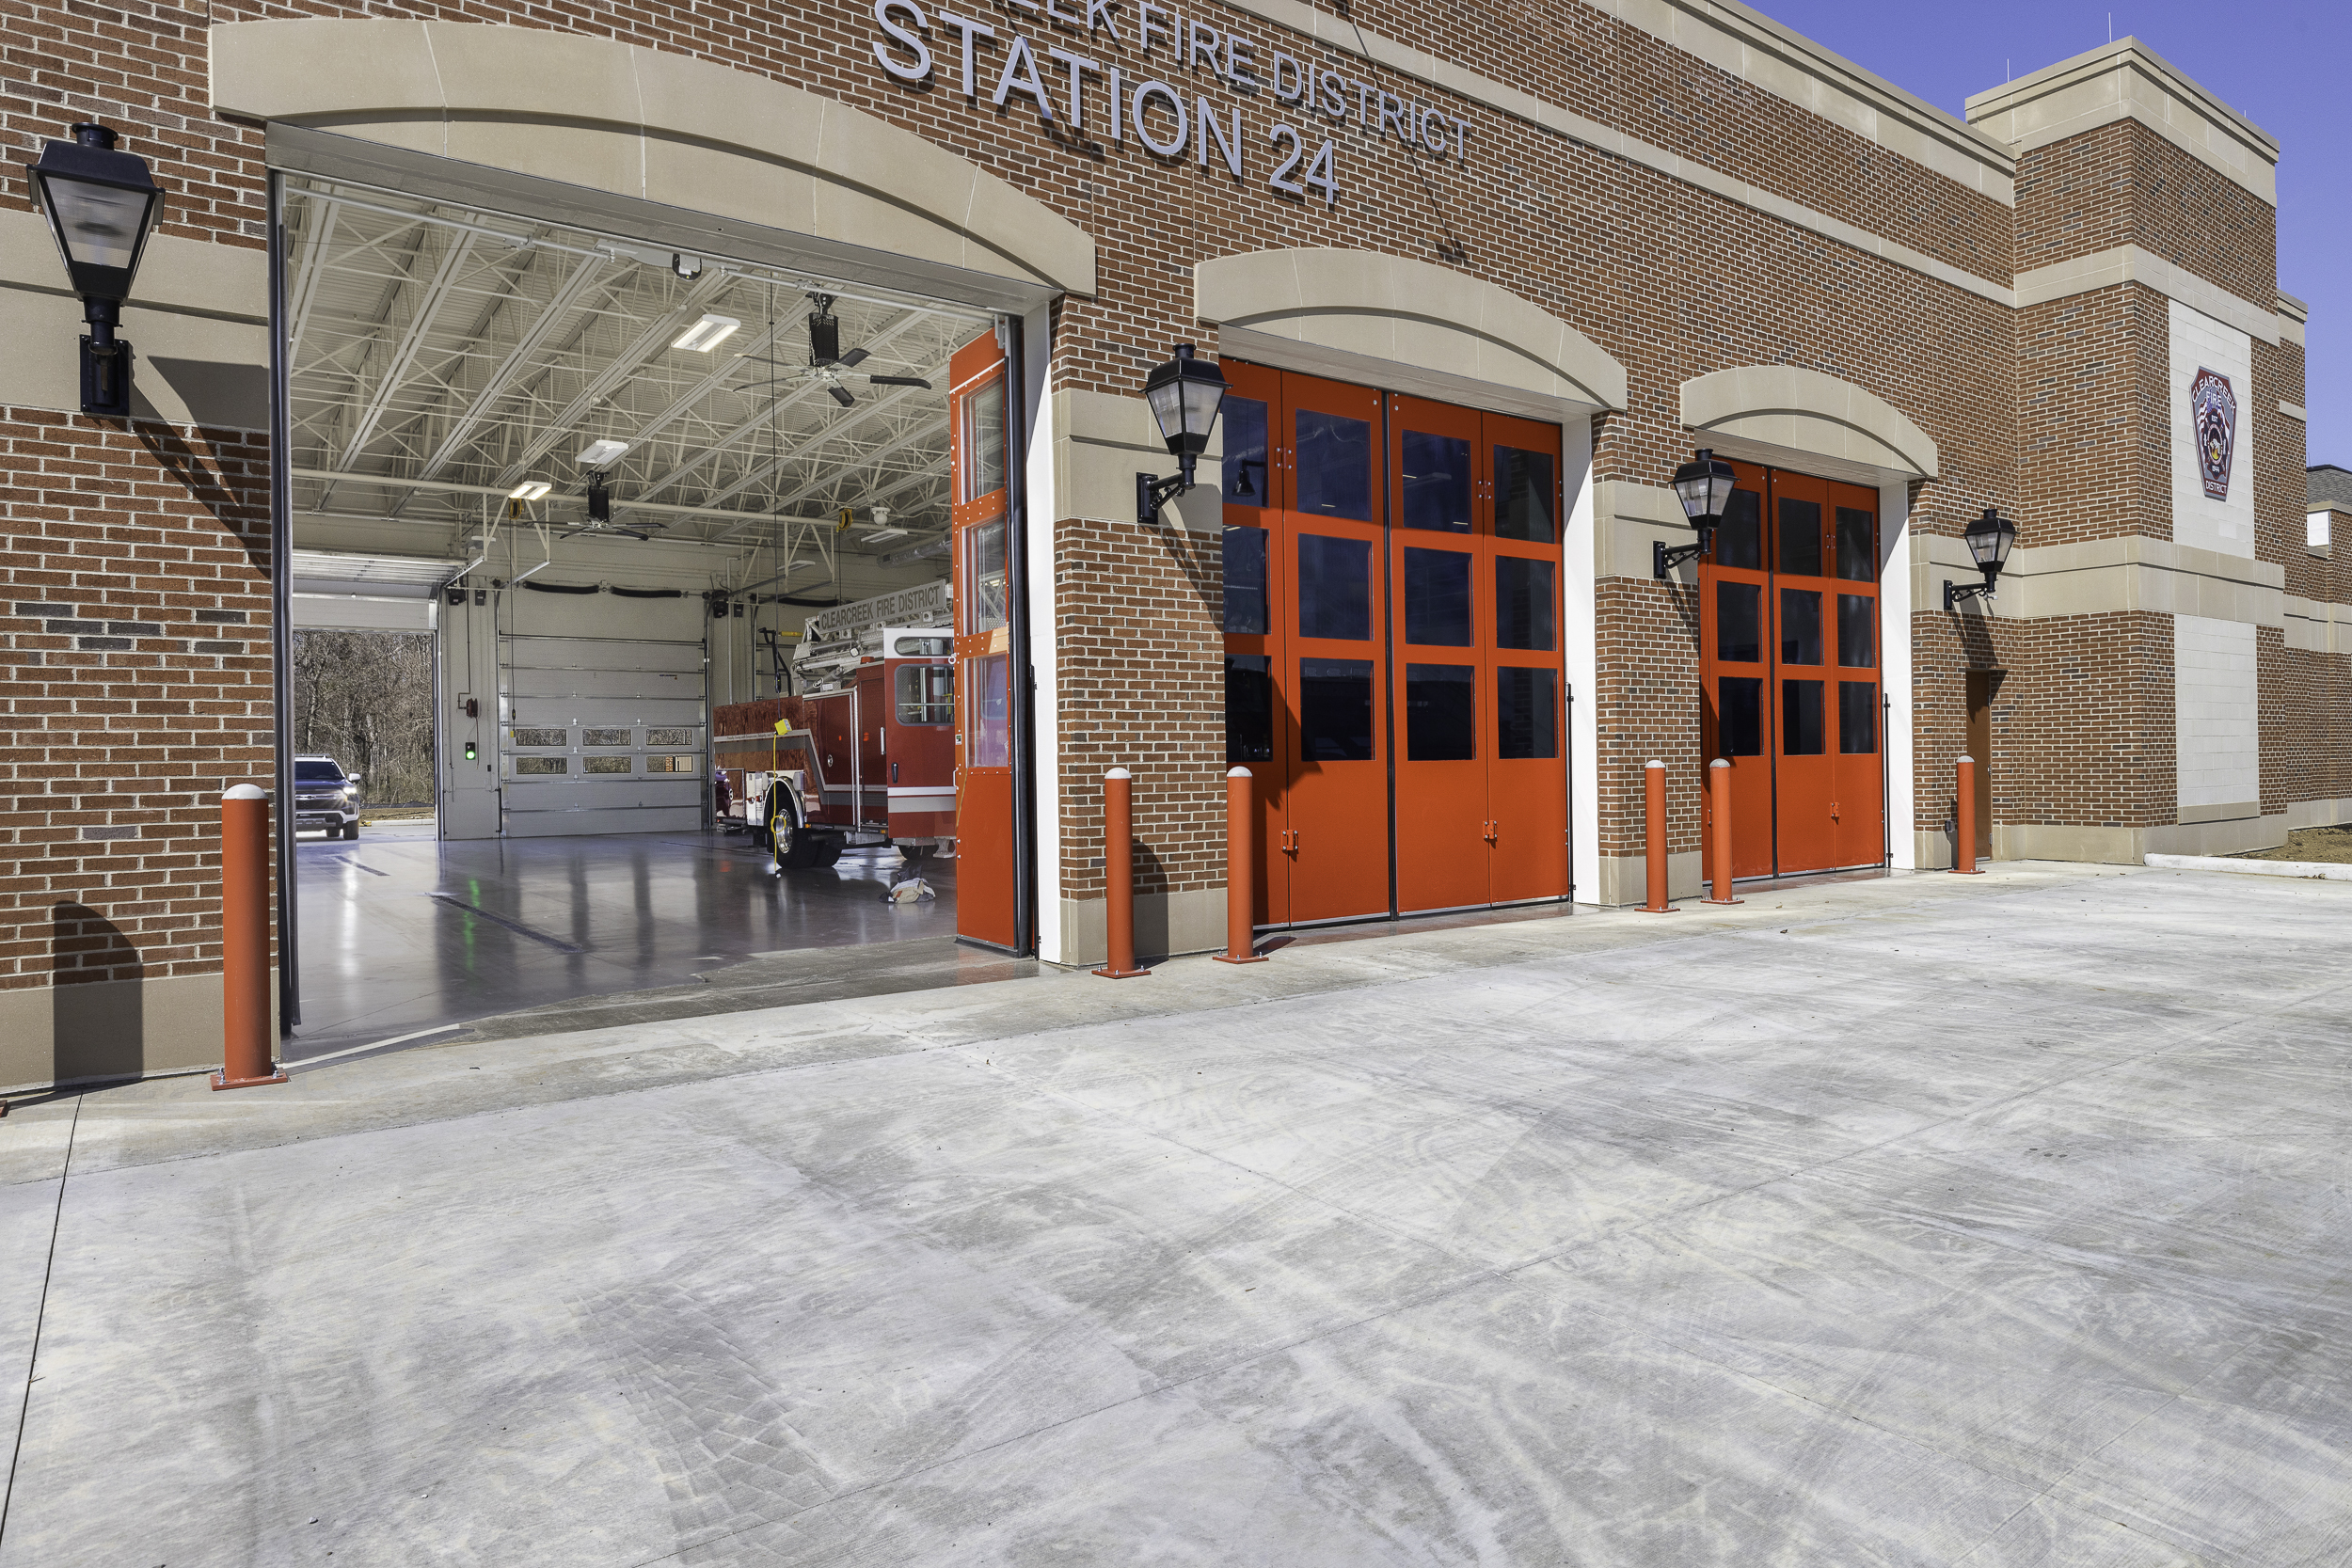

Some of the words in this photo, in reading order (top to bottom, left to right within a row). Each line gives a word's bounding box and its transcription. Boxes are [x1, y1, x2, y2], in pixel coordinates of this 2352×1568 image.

[1139, 1, 1255, 87] FIRE
[1274, 50, 1472, 160] DISTRICT
[872, 0, 1242, 178] STATION
[1270, 123, 1340, 204] 24
[2192, 375, 2236, 415] CLEARCREEK
[2206, 390, 2222, 407] FIRE
[2205, 480, 2228, 495] DISTRICT
[821, 602, 875, 630] CLEARCREEK
[876, 596, 896, 618] FIRE
[898, 585, 940, 613] DISTRICT
